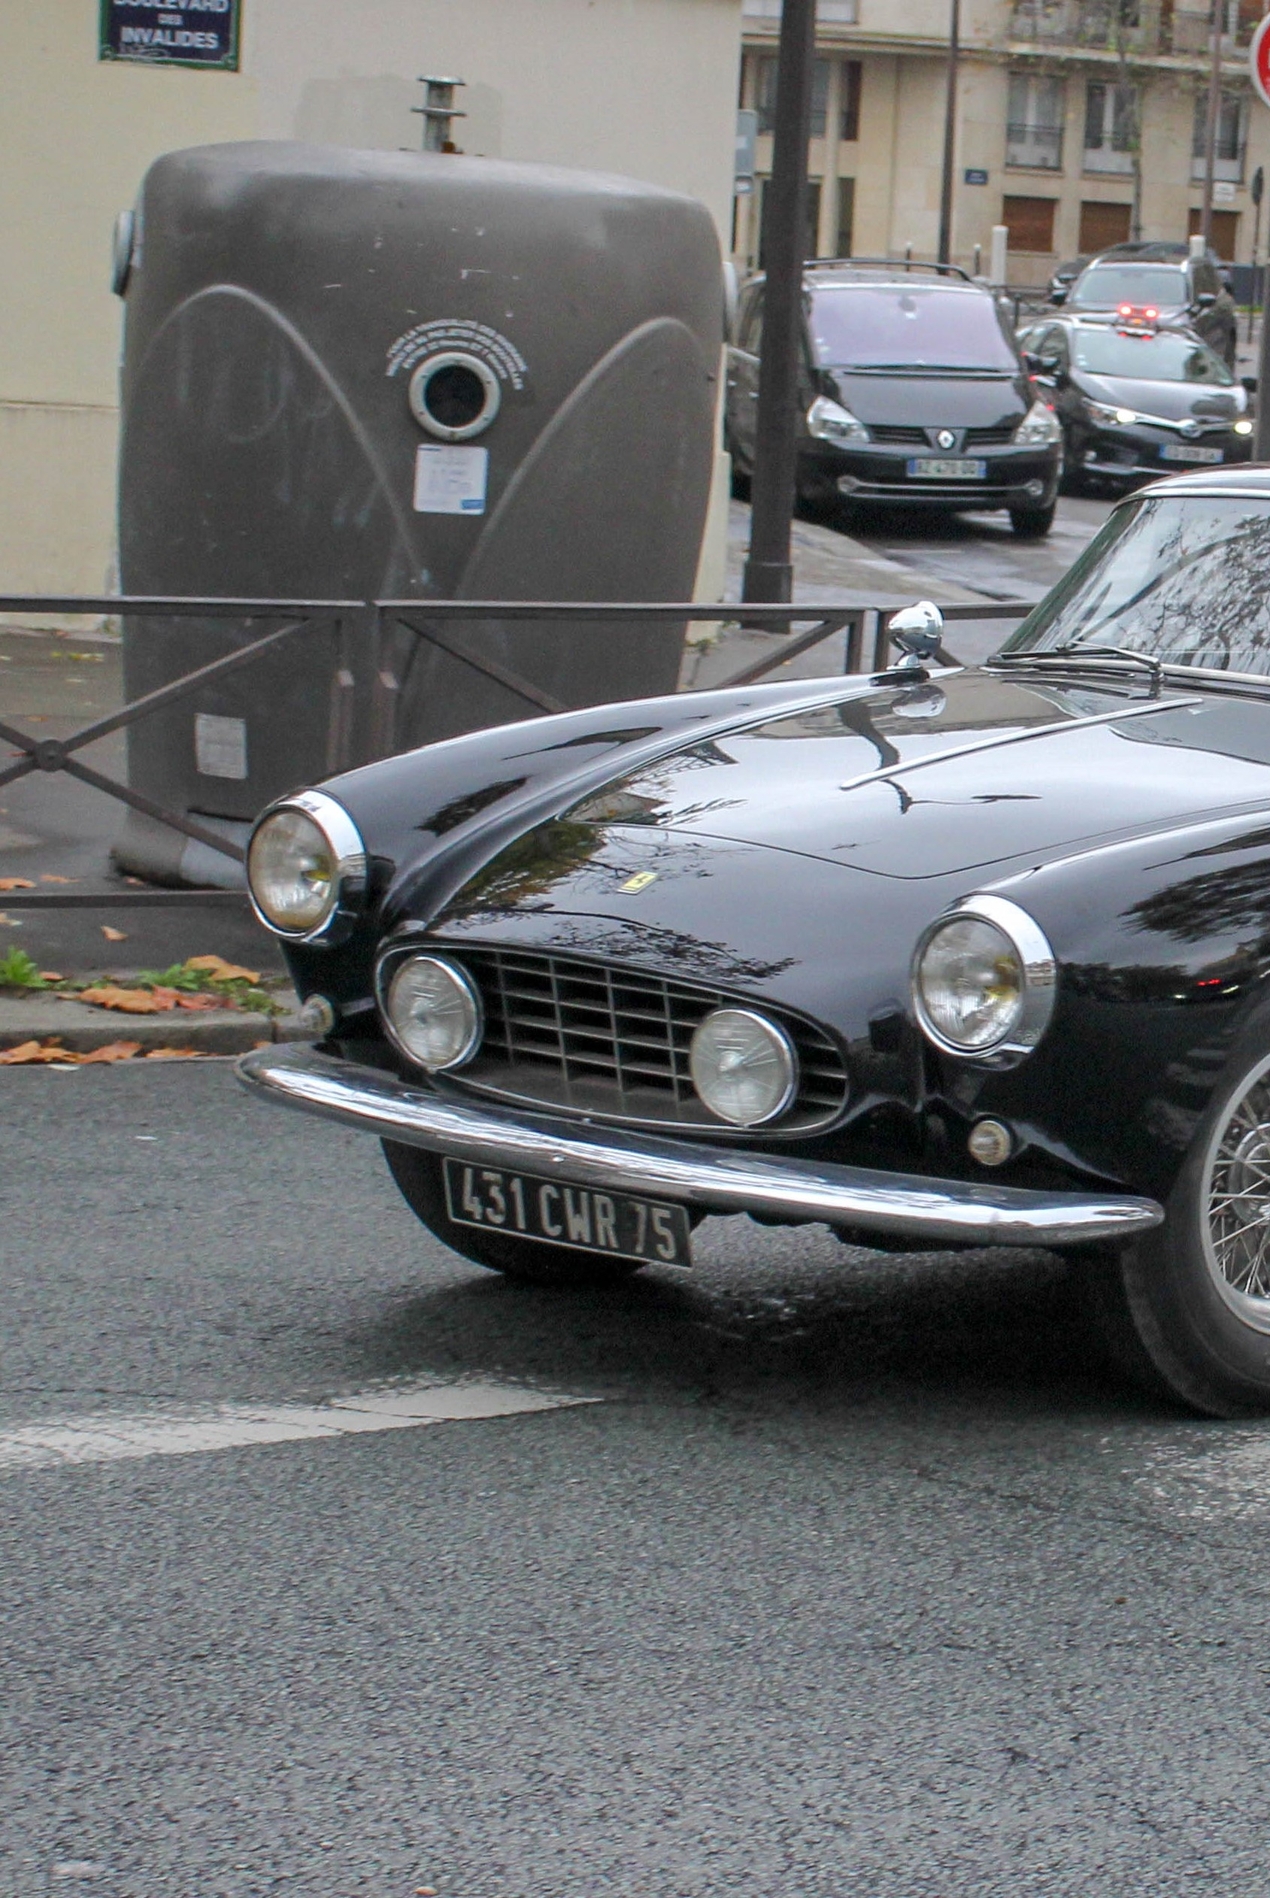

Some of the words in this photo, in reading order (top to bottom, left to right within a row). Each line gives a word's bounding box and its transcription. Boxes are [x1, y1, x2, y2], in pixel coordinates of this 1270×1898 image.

[120, 26, 219, 49] INVALIDES
[462, 1167, 527, 1230] 431
[538, 1184, 620, 1249] CWR
[628, 1201, 677, 1260] 75
